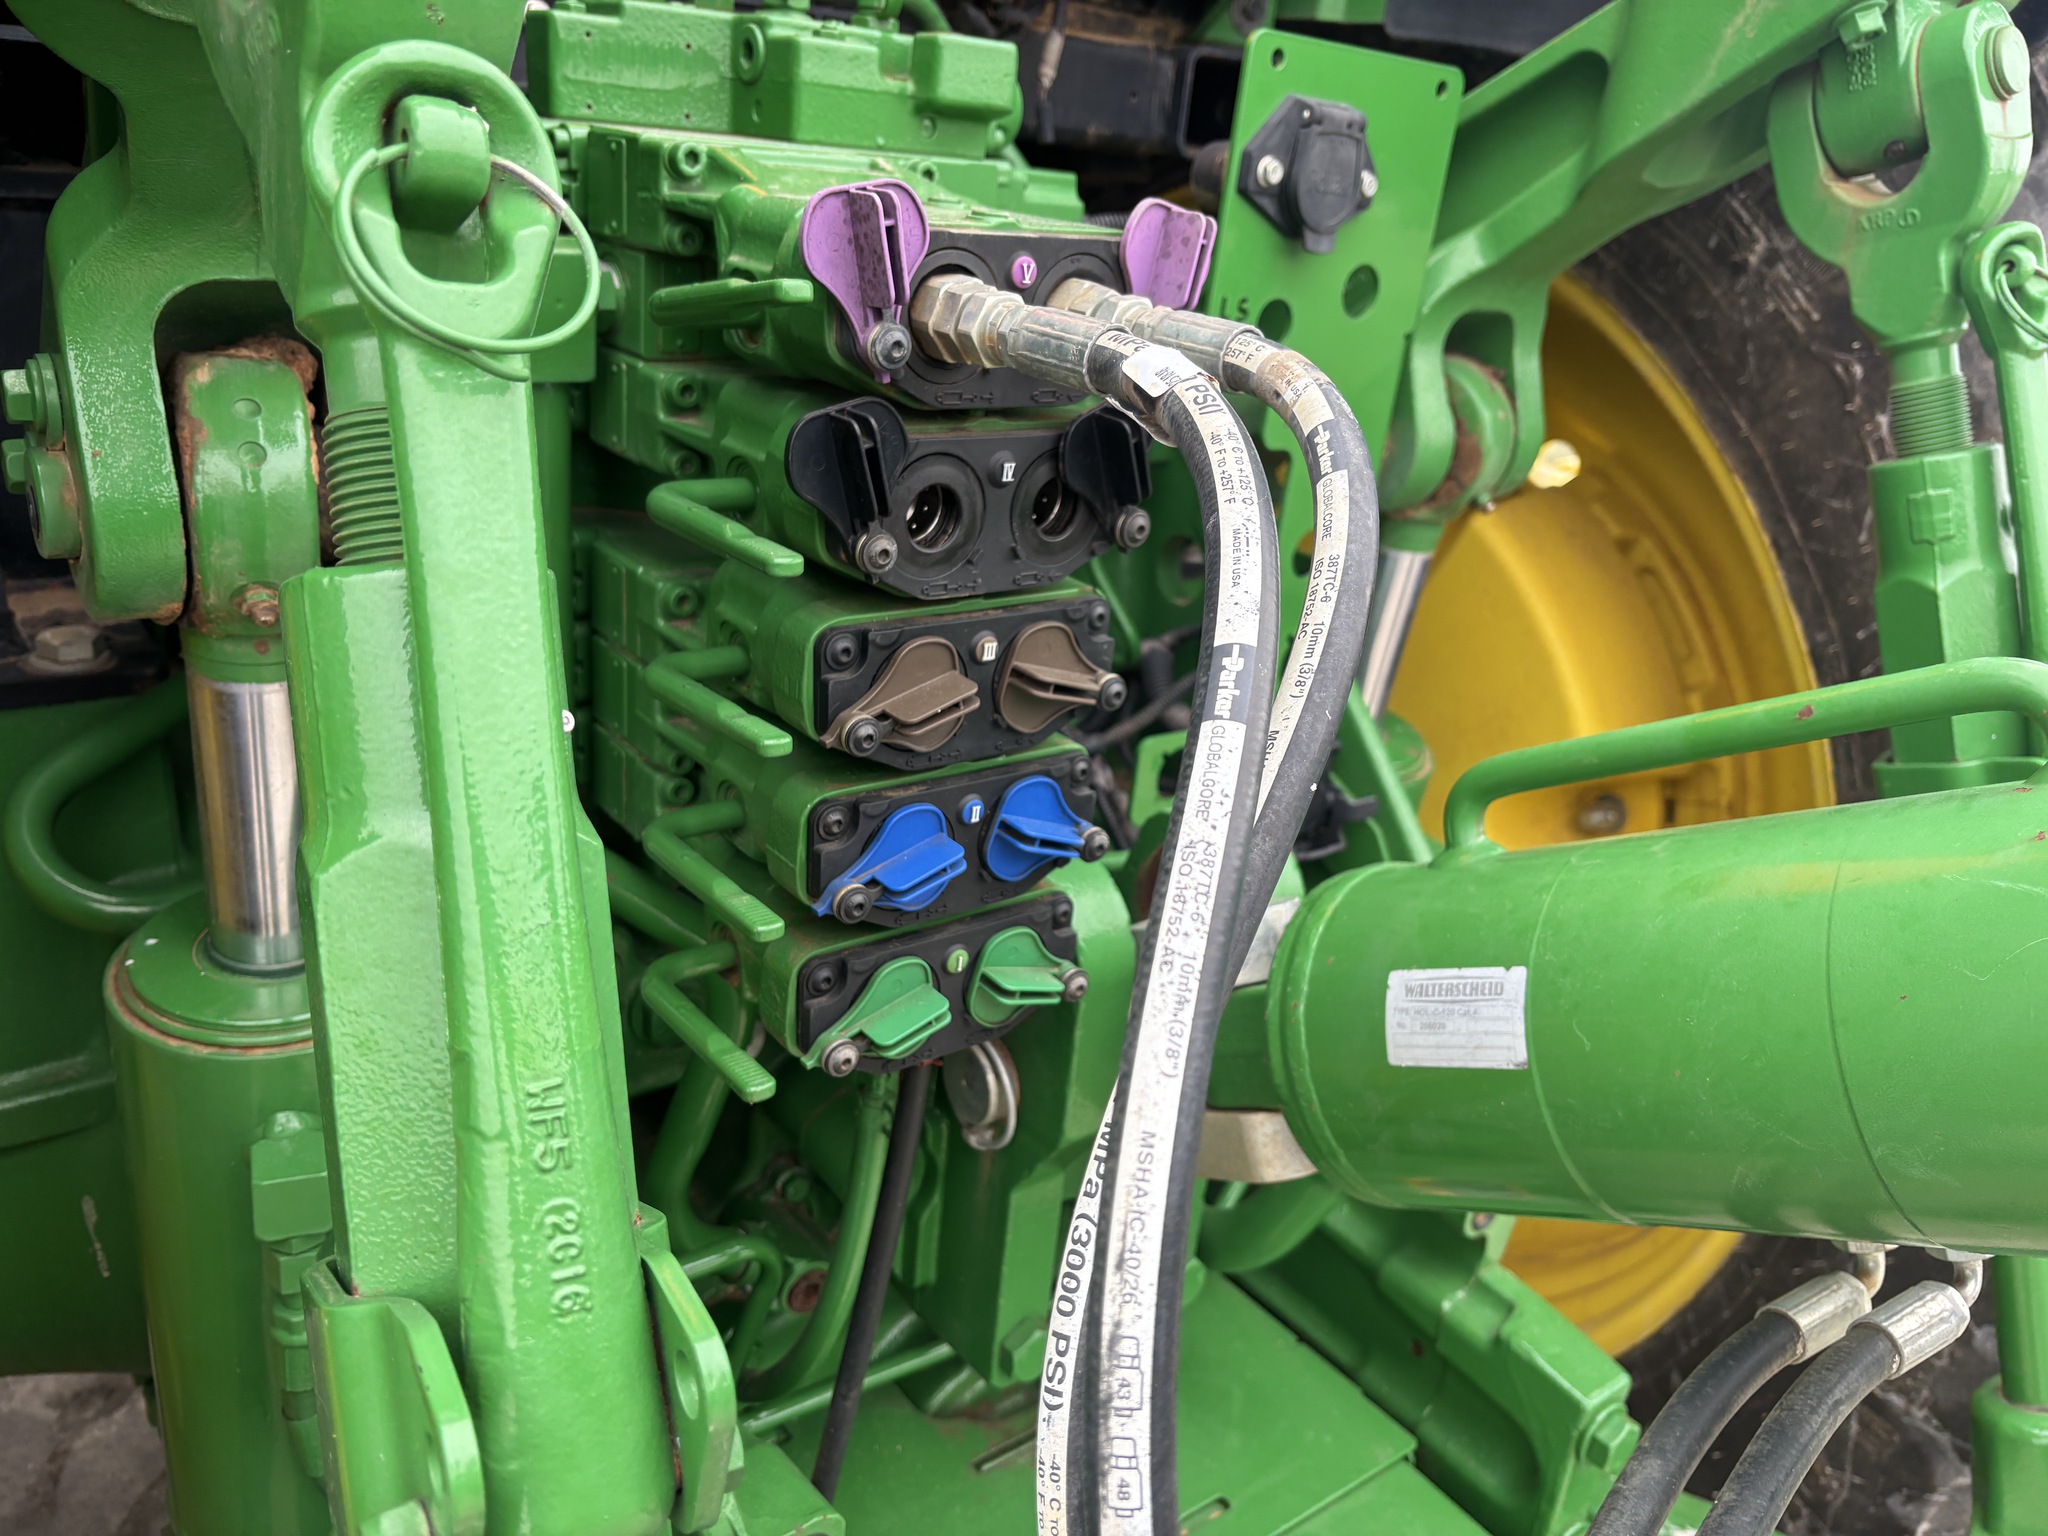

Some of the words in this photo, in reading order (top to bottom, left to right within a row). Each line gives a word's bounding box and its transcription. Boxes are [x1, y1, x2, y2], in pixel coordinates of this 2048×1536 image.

[1022, 262, 1035, 284] V
[1244, 353, 1254, 363] F
[1217, 458, 1227, 468] TO
[1234, 456, 1245, 466] TO
[1314, 426, 1334, 476] Parker
[1002, 462, 1016, 482] IV
[1321, 478, 1334, 541] GLOBALCORE
[1232, 528, 1242, 553] MADE
[1232, 555, 1242, 566] IN
[1312, 558, 1325, 580] ISO
[1231, 567, 1242, 588] USA
[1320, 554, 1341, 603] 387TC-6
[1297, 582, 1320, 640] 18752-AC
[982, 642, 998, 662] III
[1305, 621, 1325, 659] 10mm
[1214, 648, 1245, 719] Parker
[971, 805, 981, 823] II
[1179, 842, 1196, 877] ISO
[1190, 845, 1217, 922] 387TC-6
[1159, 884, 1187, 973] 18752-AC
[1404, 981, 1504, 998] WALTERSCHEID
[1161, 1019, 1188, 1079] (3/8")
[1134, 1130, 1156, 1200] MSHA
[1056, 1213, 1097, 1318] (3000
[1121, 1209, 1148, 1305] IC-40/26
[1043, 1330, 1071, 1411] PSI)
[1038, 1491, 1047, 1506] F
[1117, 1477, 1131, 1501] 48
[1049, 1497, 1061, 1512] C
[1039, 1510, 1045, 1530] TO
